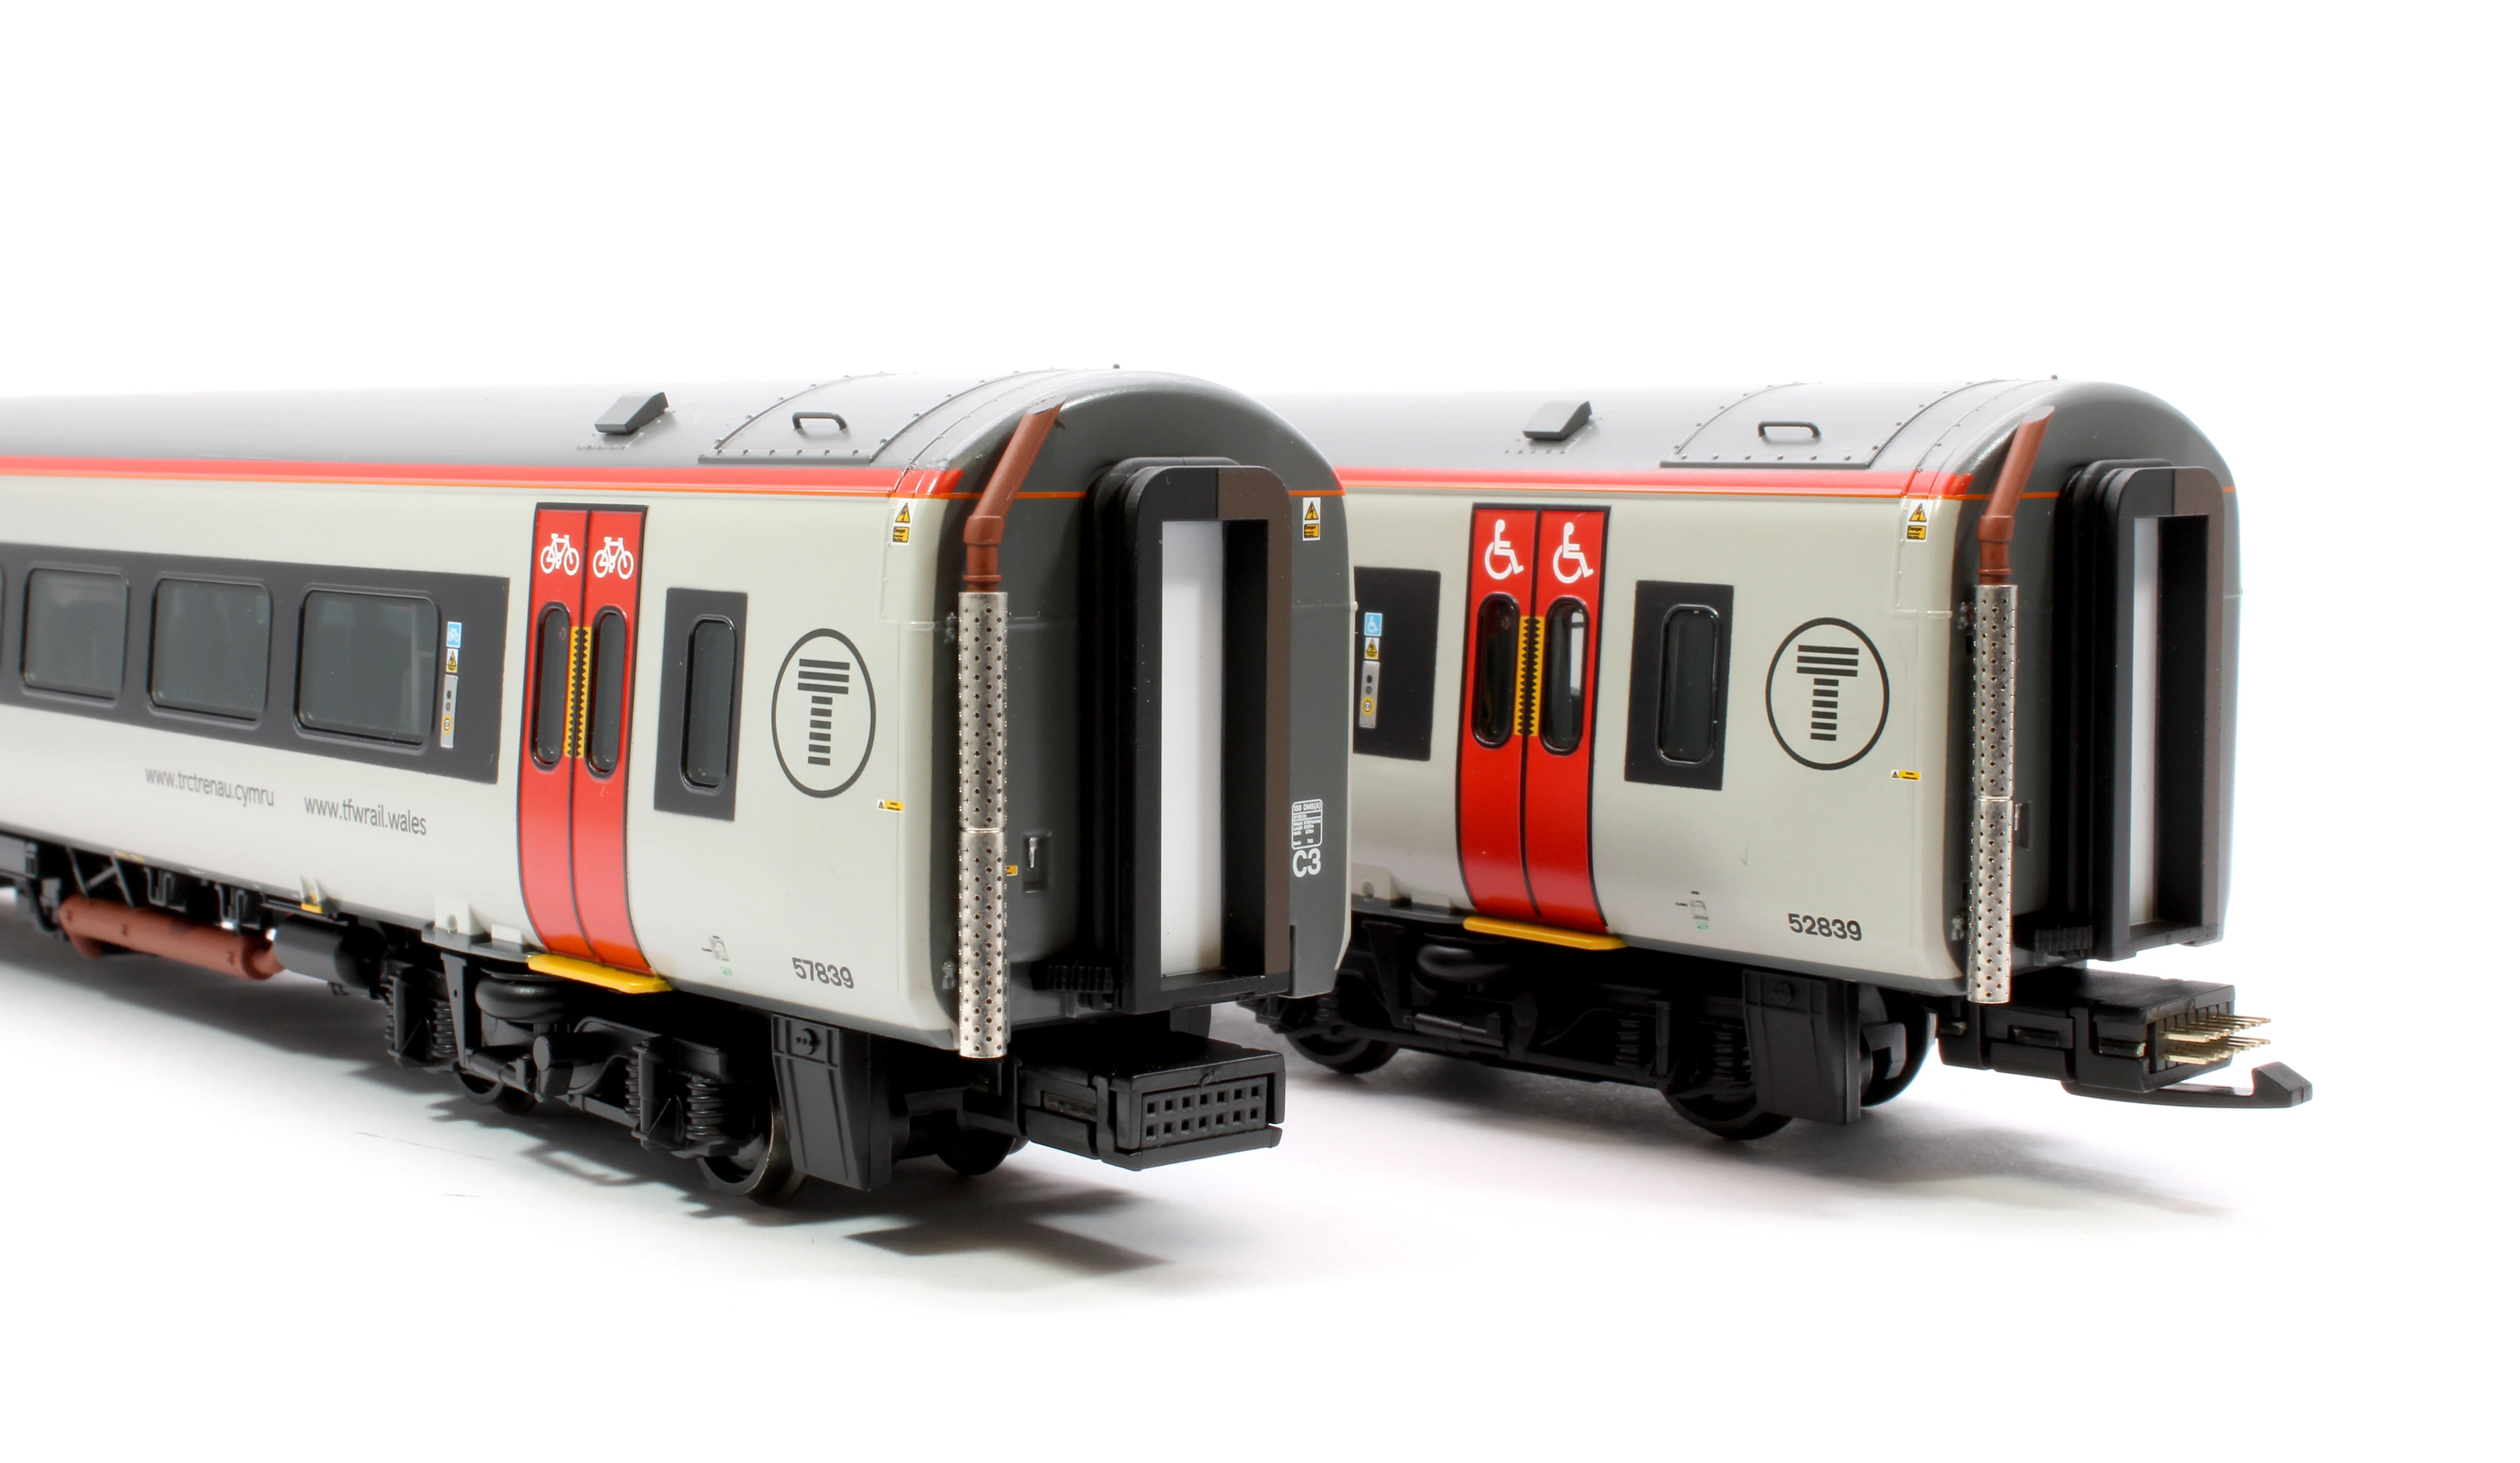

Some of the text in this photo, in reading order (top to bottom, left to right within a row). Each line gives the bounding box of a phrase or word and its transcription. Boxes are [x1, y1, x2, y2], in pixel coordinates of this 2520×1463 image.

[145, 768, 274, 808] www.trctrenau.cymru
[304, 796, 427, 836] www.tfwrail.wales
[1292, 847, 1322, 878] C3
[1788, 913, 1862, 941] 52839
[792, 957, 854, 989] 57839
